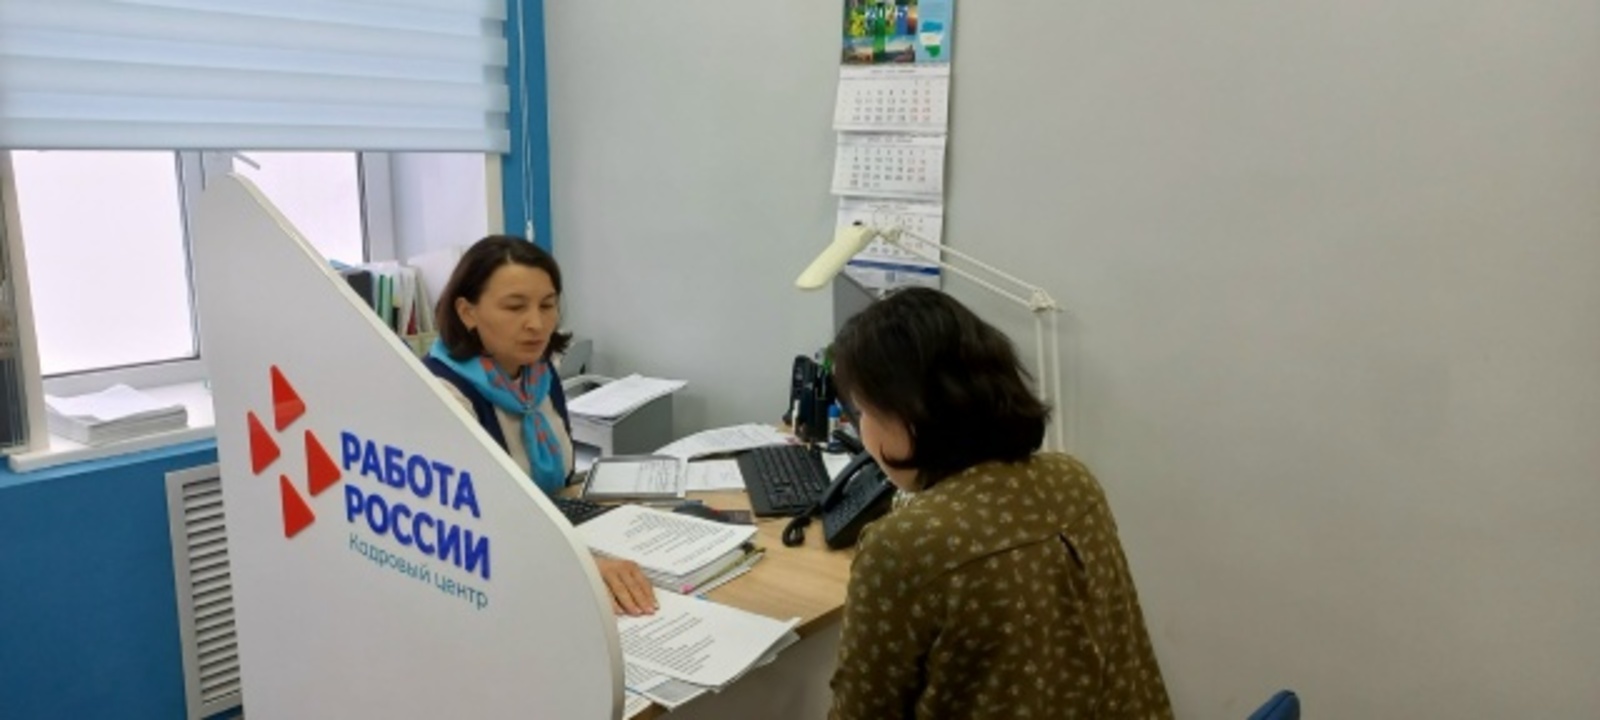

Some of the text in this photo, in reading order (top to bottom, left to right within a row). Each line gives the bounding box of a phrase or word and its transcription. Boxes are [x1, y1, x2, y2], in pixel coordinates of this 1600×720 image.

[341, 431, 481, 519] РАБОТА
[344, 484, 491, 581] РОССИИ
[348, 531, 489, 611] Кадровый центр
